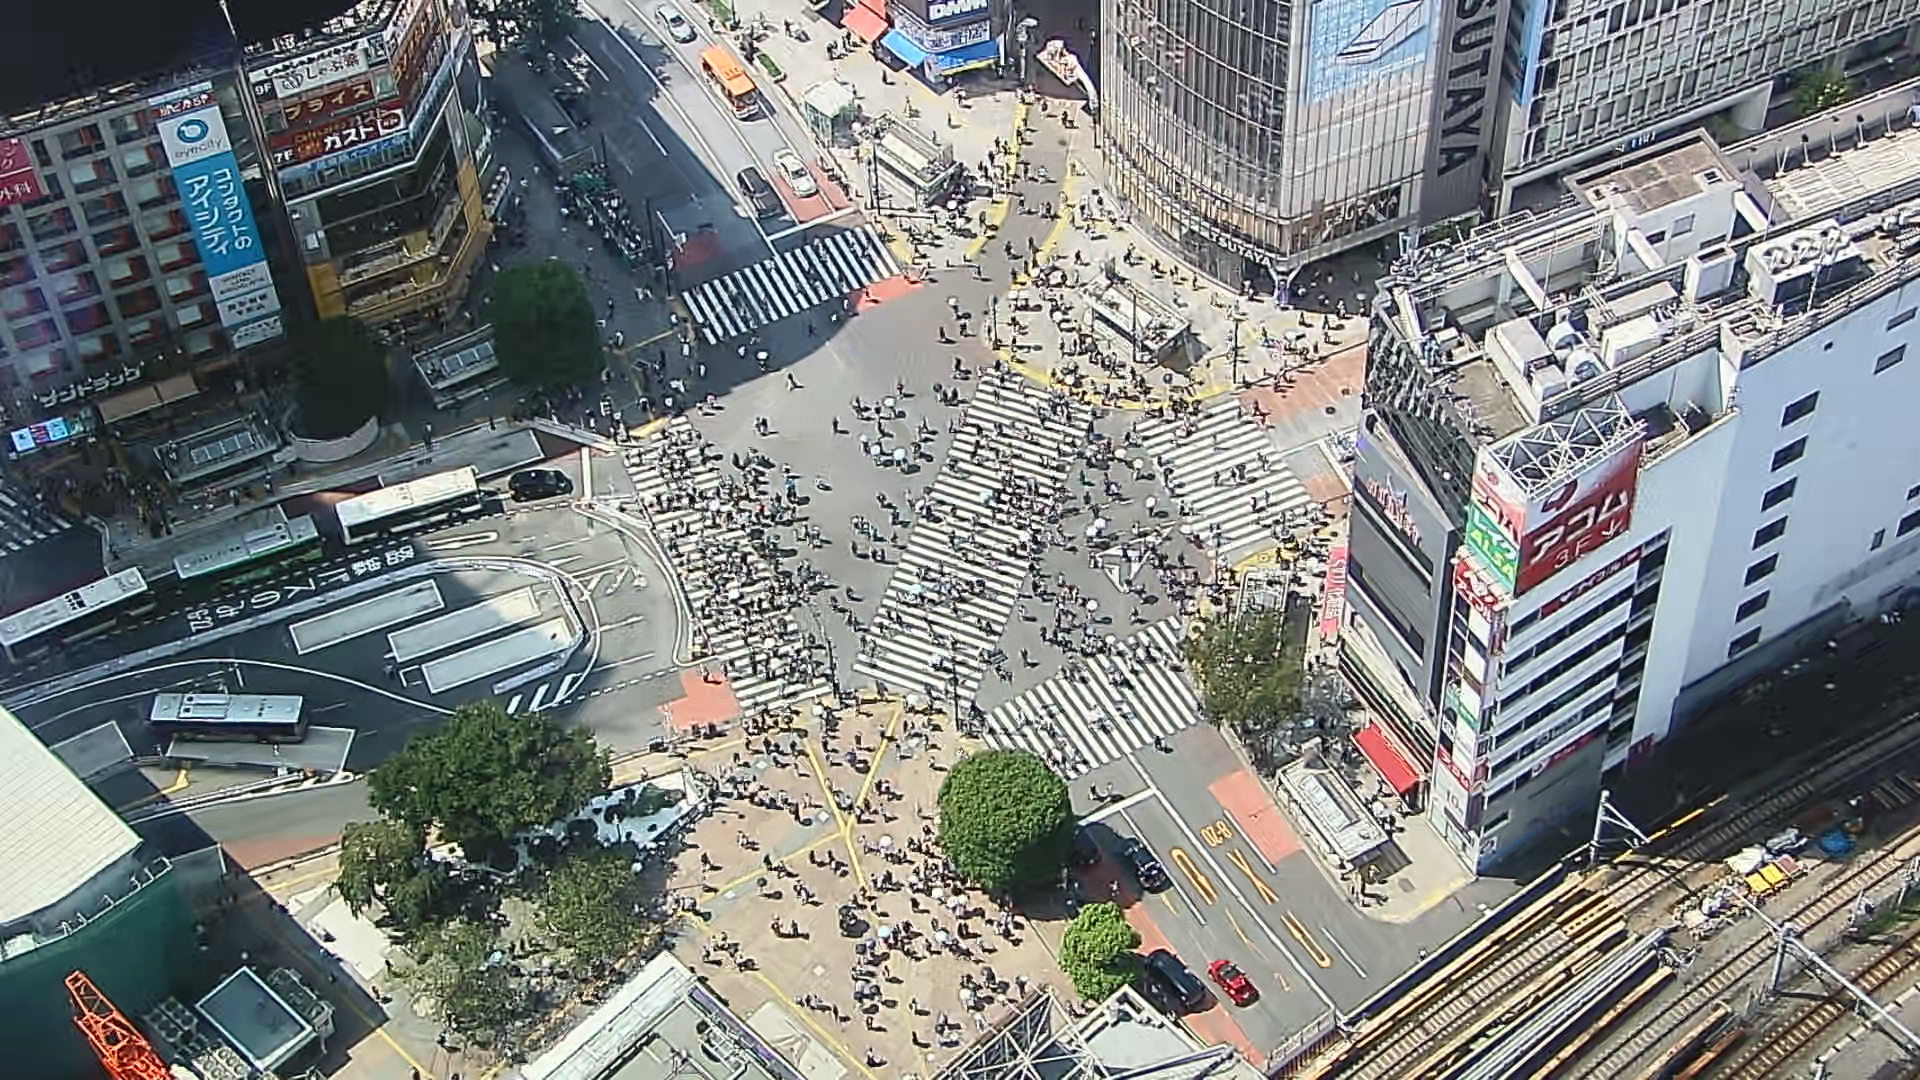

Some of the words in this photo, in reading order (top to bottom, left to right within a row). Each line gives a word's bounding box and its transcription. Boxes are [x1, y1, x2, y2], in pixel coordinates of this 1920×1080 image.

[324, 125, 374, 153] ガスト
[1529, 491, 1629, 565] アコム
